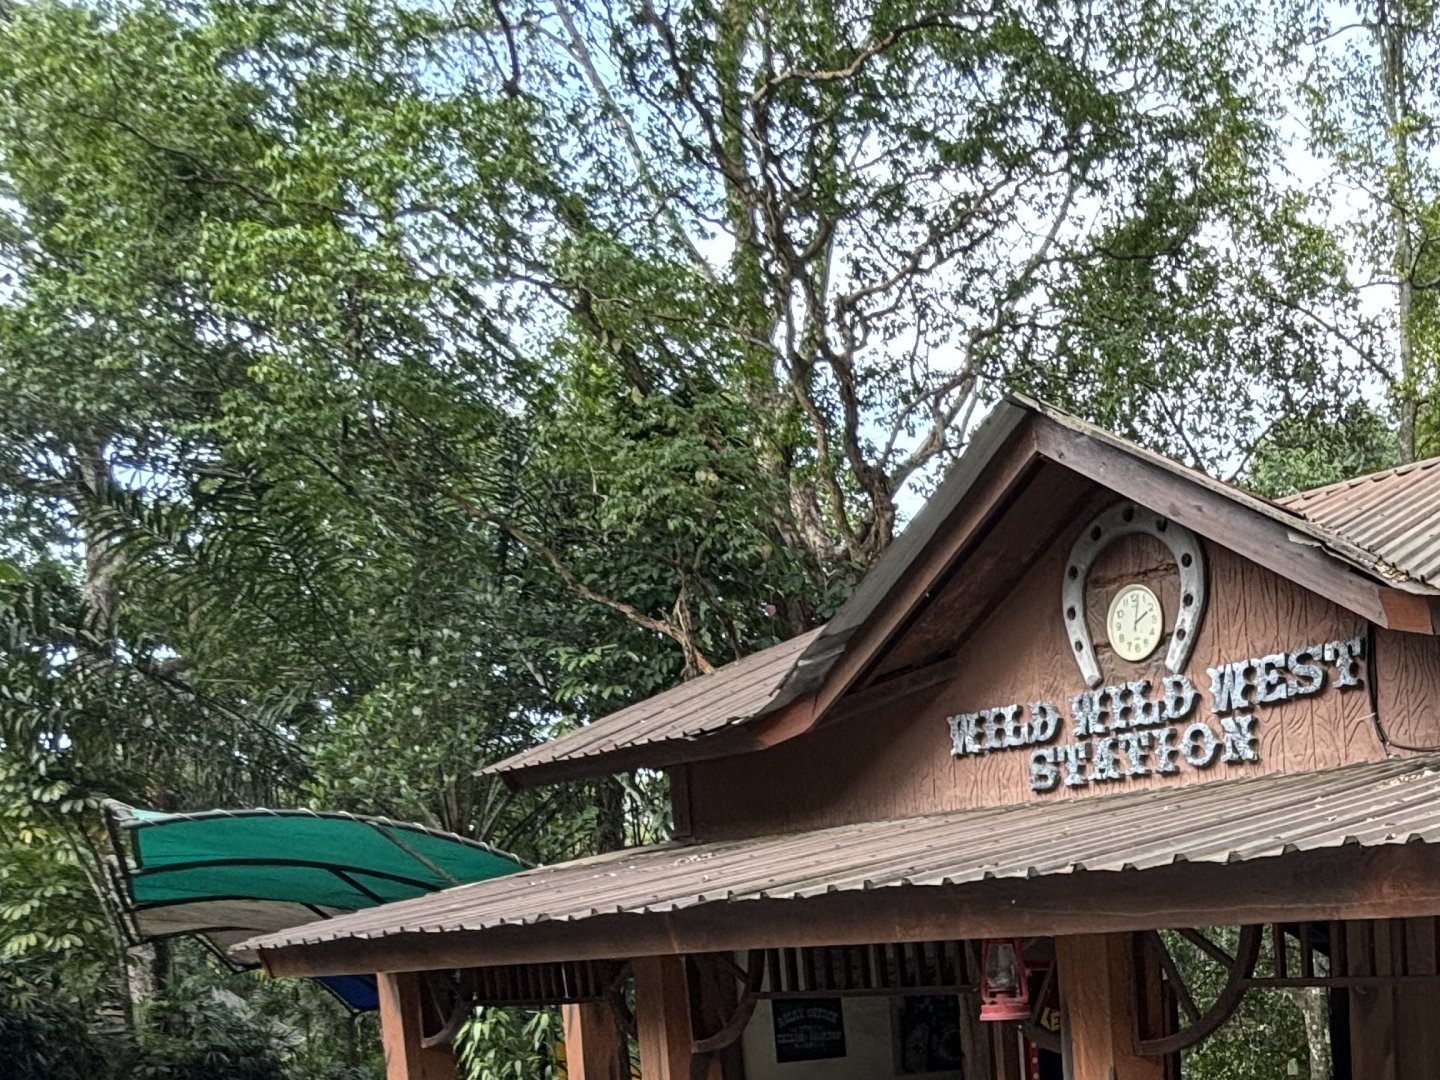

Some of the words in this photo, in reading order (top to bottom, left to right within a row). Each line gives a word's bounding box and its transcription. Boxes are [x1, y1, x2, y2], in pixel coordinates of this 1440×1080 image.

[947, 701, 1063, 757] WILD
[1068, 674, 1199, 738] WILD
[1206, 637, 1365, 714] WEST
[1028, 715, 1260, 793] STATION
